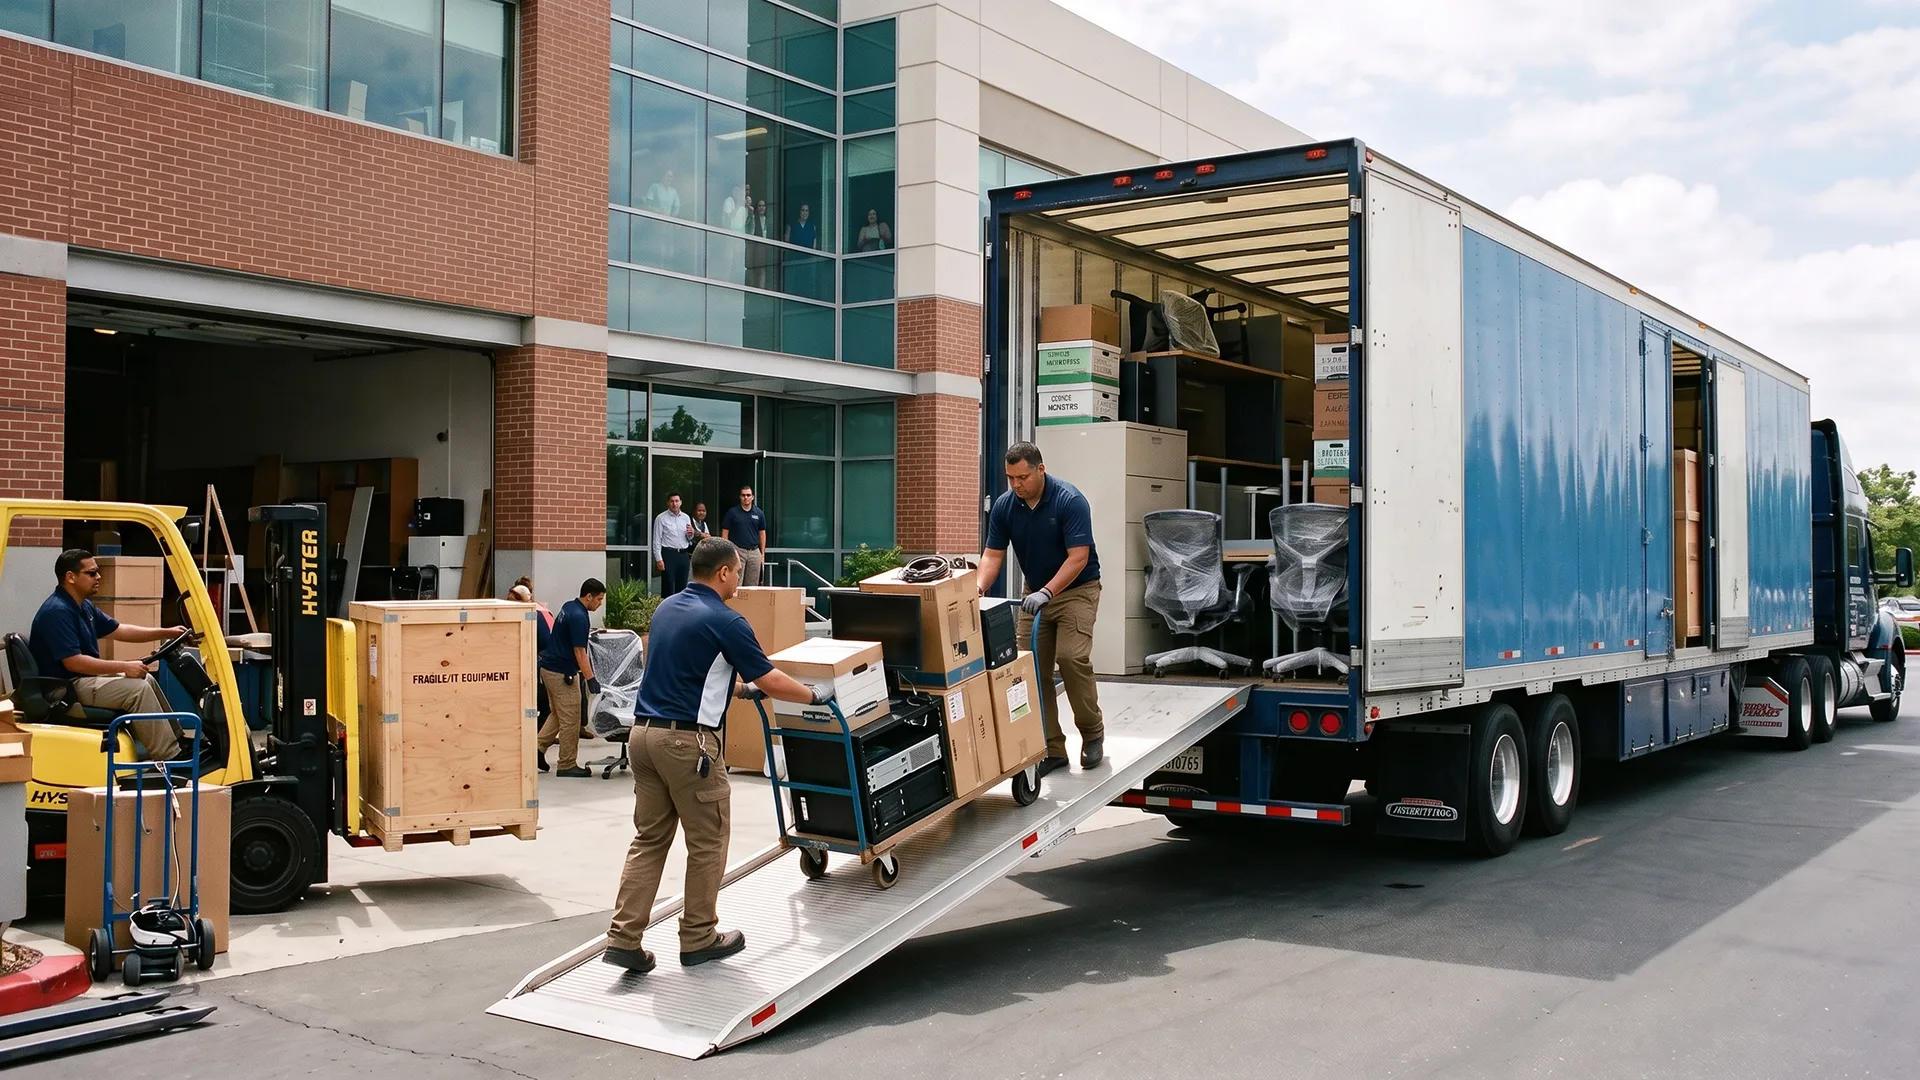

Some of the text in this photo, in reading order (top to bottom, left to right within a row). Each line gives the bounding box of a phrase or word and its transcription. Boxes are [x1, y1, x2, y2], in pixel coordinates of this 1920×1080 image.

[301, 529, 318, 615] HYSTER
[412, 671, 510, 684] FRAGILE/IT EQUIPMENT
